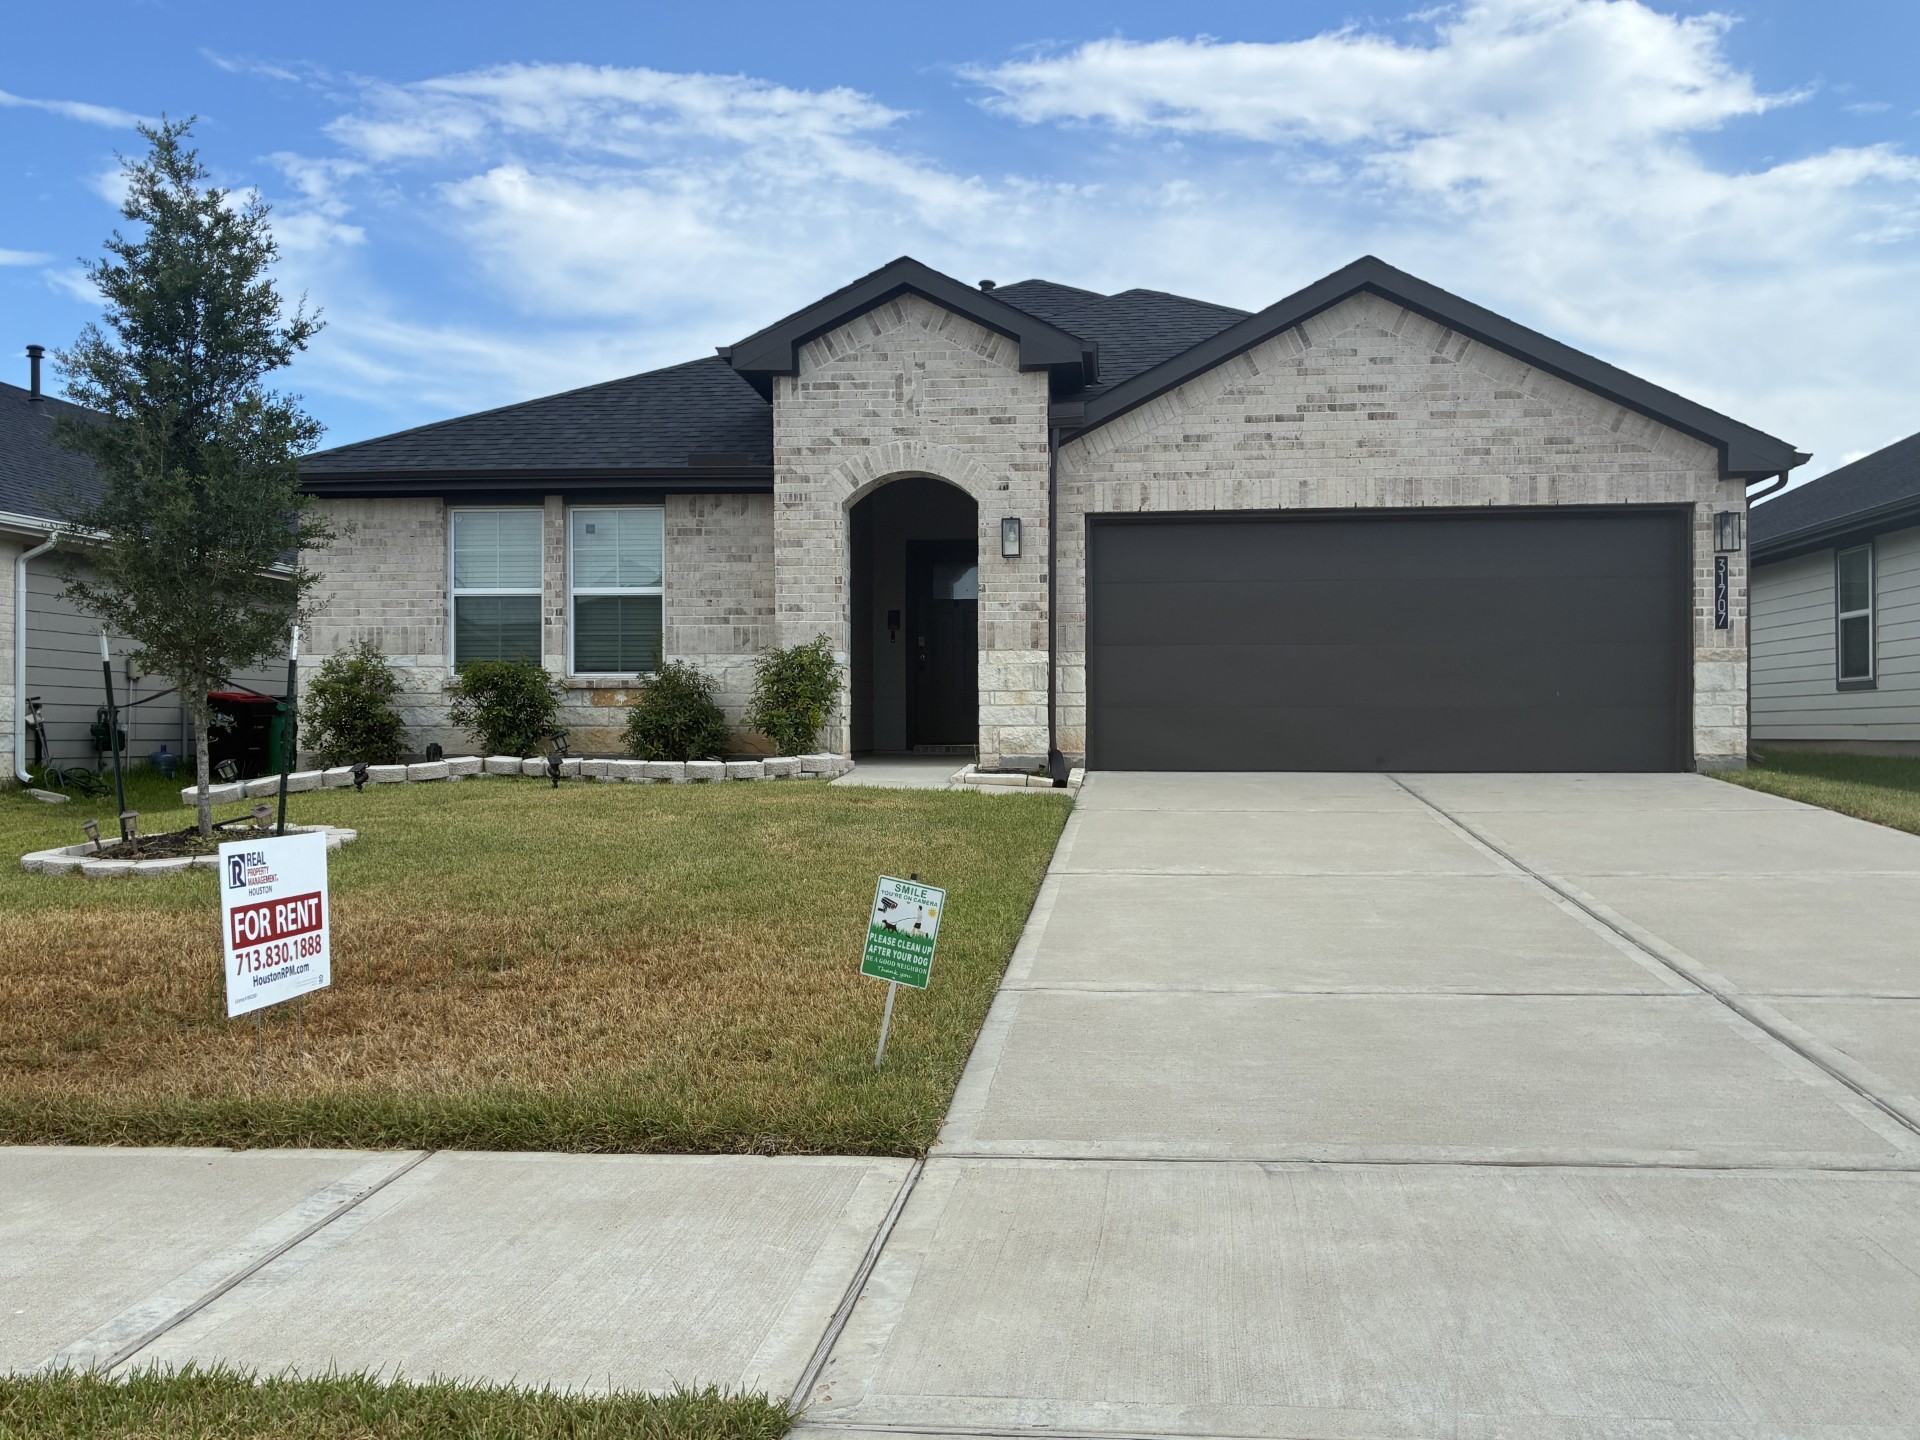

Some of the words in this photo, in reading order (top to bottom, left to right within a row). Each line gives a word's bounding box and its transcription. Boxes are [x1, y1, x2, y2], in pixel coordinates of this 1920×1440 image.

[1717, 558, 1726, 626] 31707
[246, 851, 266, 867] REAL
[247, 866, 270, 877] PROPERTY
[248, 885, 273, 896] HOUSTON
[881, 889, 903, 900] YOU'RE
[903, 894, 912, 902] ON
[913, 897, 938, 908] CAMERA
[894, 883, 928, 899] SMILE
[234, 907, 271, 943] FOR
[275, 898, 319, 934] RENT
[869, 932, 897, 947] PLEASE
[897, 939, 921, 953] CLEAN
[921, 945, 932, 955] UP
[235, 934, 322, 976] 713.830.1888
[865, 954, 873, 962] BE
[878, 957, 896, 967] GOOD
[868, 944, 892, 957] AFTER
[892, 949, 912, 963] YOUR
[912, 954, 929, 966] DOG
[252, 963, 310, 987] HoustonRPM.com
[877, 965, 899, 976] Thank
